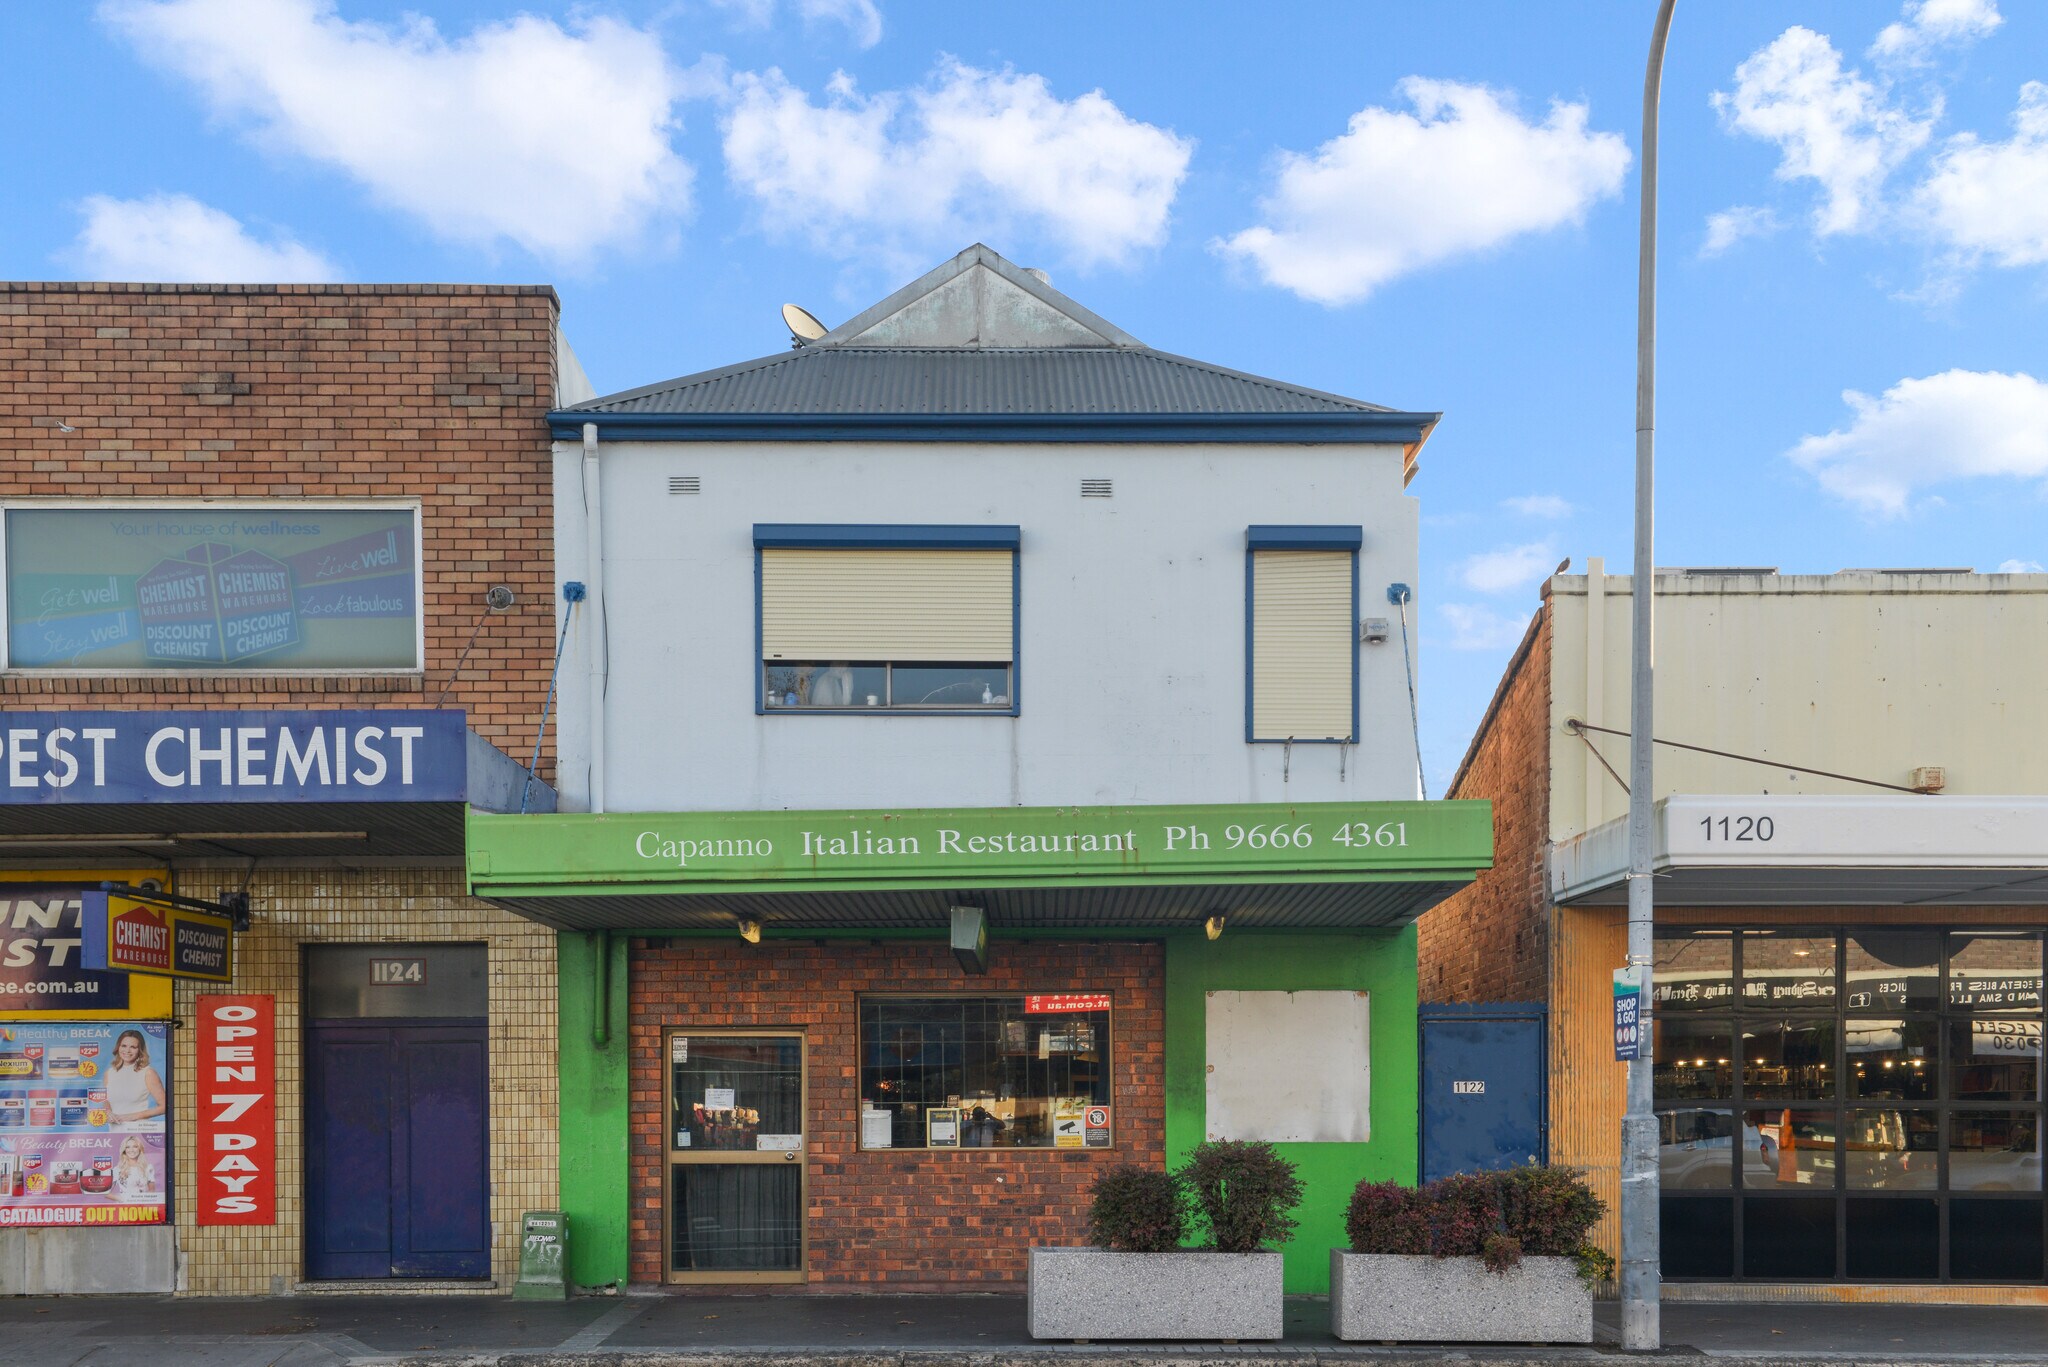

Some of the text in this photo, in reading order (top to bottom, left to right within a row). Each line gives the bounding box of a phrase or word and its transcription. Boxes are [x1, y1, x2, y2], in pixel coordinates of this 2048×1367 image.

[110, 521, 321, 536] Your house of wellness
[360, 530, 398, 569] well
[81, 575, 119, 605] well
[140, 574, 207, 605] CHEMIST
[217, 571, 286, 596] CHEMIST
[143, 600, 208, 617] WAREHOUSE
[222, 592, 288, 609] WAREHOUSE
[346, 594, 403, 612] fabulous
[90, 611, 128, 643] well
[147, 623, 213, 640] DISCOUNT
[226, 611, 291, 638] DISCOUNT
[153, 642, 209, 657] CHEMIST
[236, 627, 289, 654] CHEMIST
[0, 726, 424, 788] EST CHEMIST
[1700, 816, 1774, 842] 1120
[635, 821, 1409, 867] Capanno Italian Restaurant Ph 9666 4361
[116, 920, 168, 951] CHEMIST
[178, 928, 226, 950] DISCOUNT
[0, 938, 82, 967] ST
[116, 949, 168, 966] WAREHOUSE
[182, 947, 222, 968] CHEMIST
[374, 962, 422, 982] 1124
[1616, 998, 1636, 1013] SHOP
[1617, 1010, 1636, 1025] & GO!
[17, 1029, 112, 1042] Healthy BREAK
[1455, 1082, 1484, 1093] 1122
[211, 1005, 265, 1214] OPEN 7 DAYS
[20, 1137, 112, 1153] Beauty BREAK
[0, 1206, 160, 1223] CATALOGUE OUT NOW!
